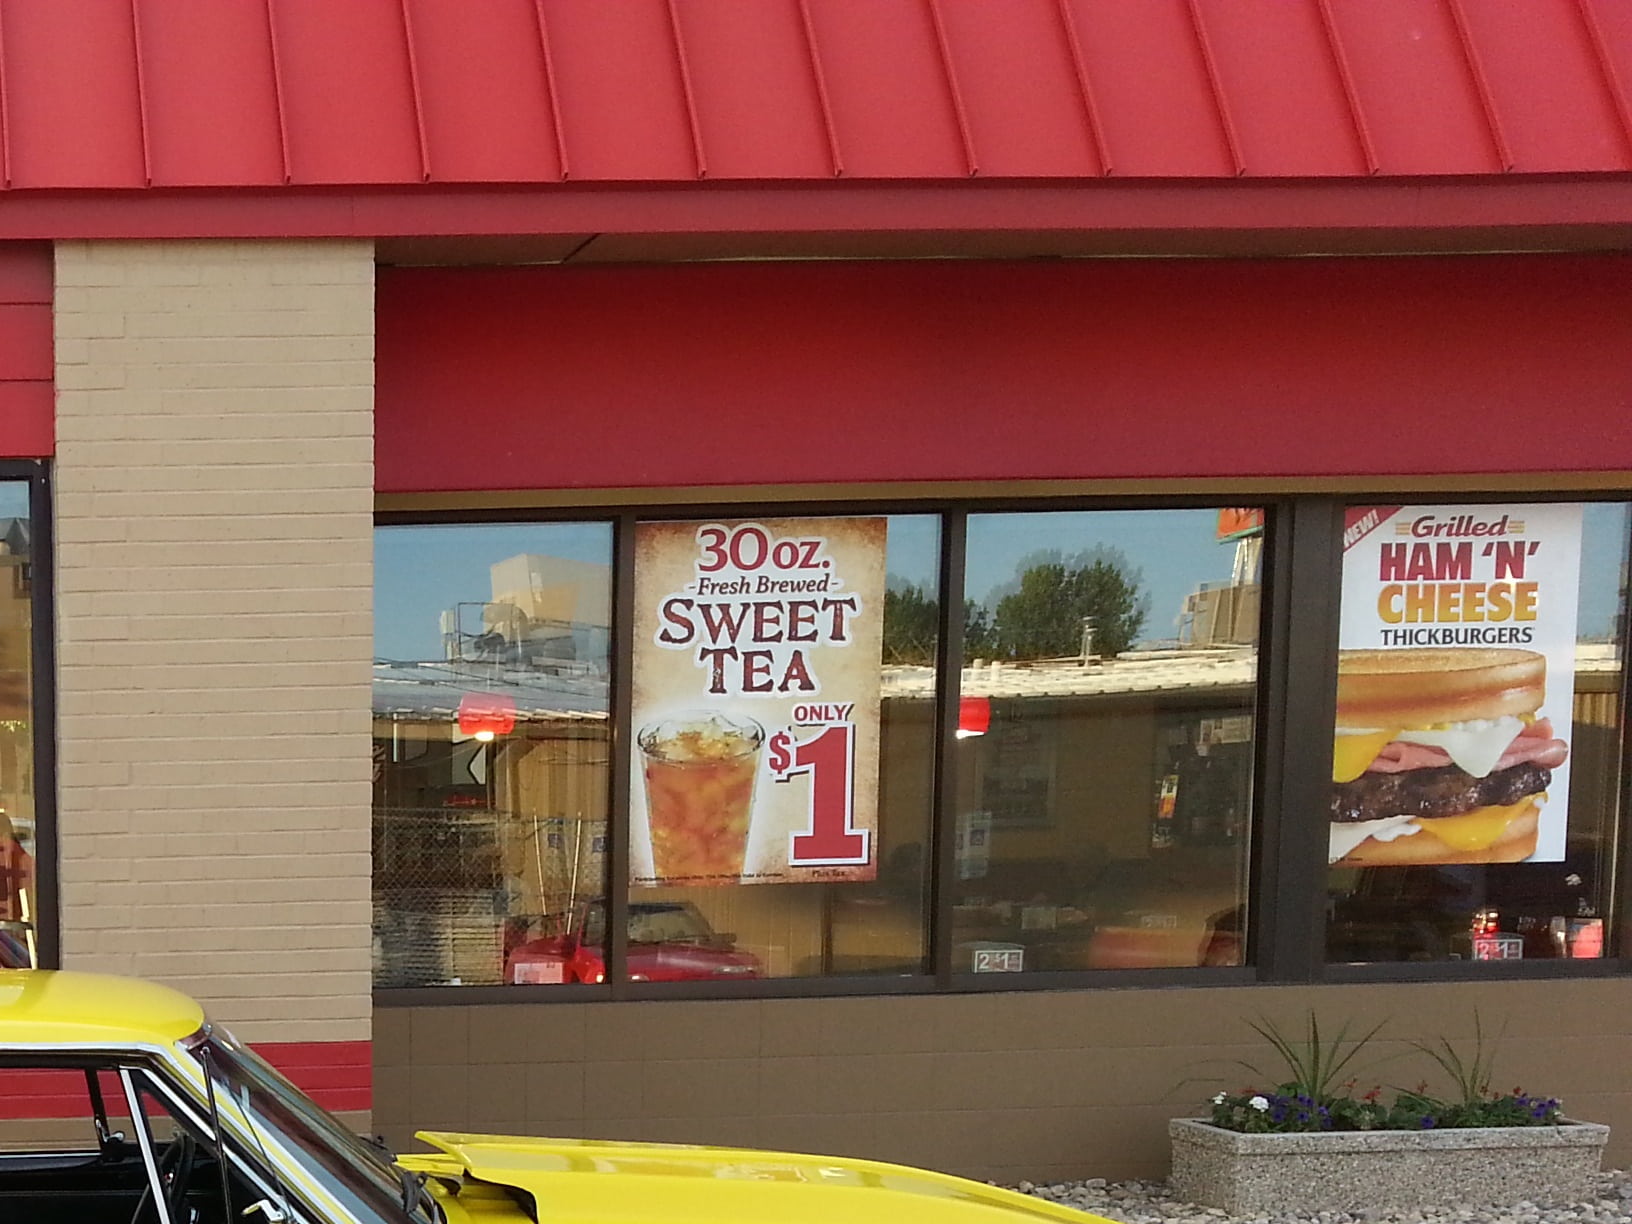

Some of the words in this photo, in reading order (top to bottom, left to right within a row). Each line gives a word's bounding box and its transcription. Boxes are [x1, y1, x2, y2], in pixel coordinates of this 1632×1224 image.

[1344, 509, 1380, 547] NEW!
[1411, 515, 1510, 538] Grilled
[1379, 541, 1472, 581] HAM
[659, 597, 858, 645] SWEET
[1377, 582, 1539, 624] CHEESE
[1380, 627, 1533, 646] THICKBURGERS
[699, 646, 816, 694] TEA
[794, 704, 848, 722] ONLY
